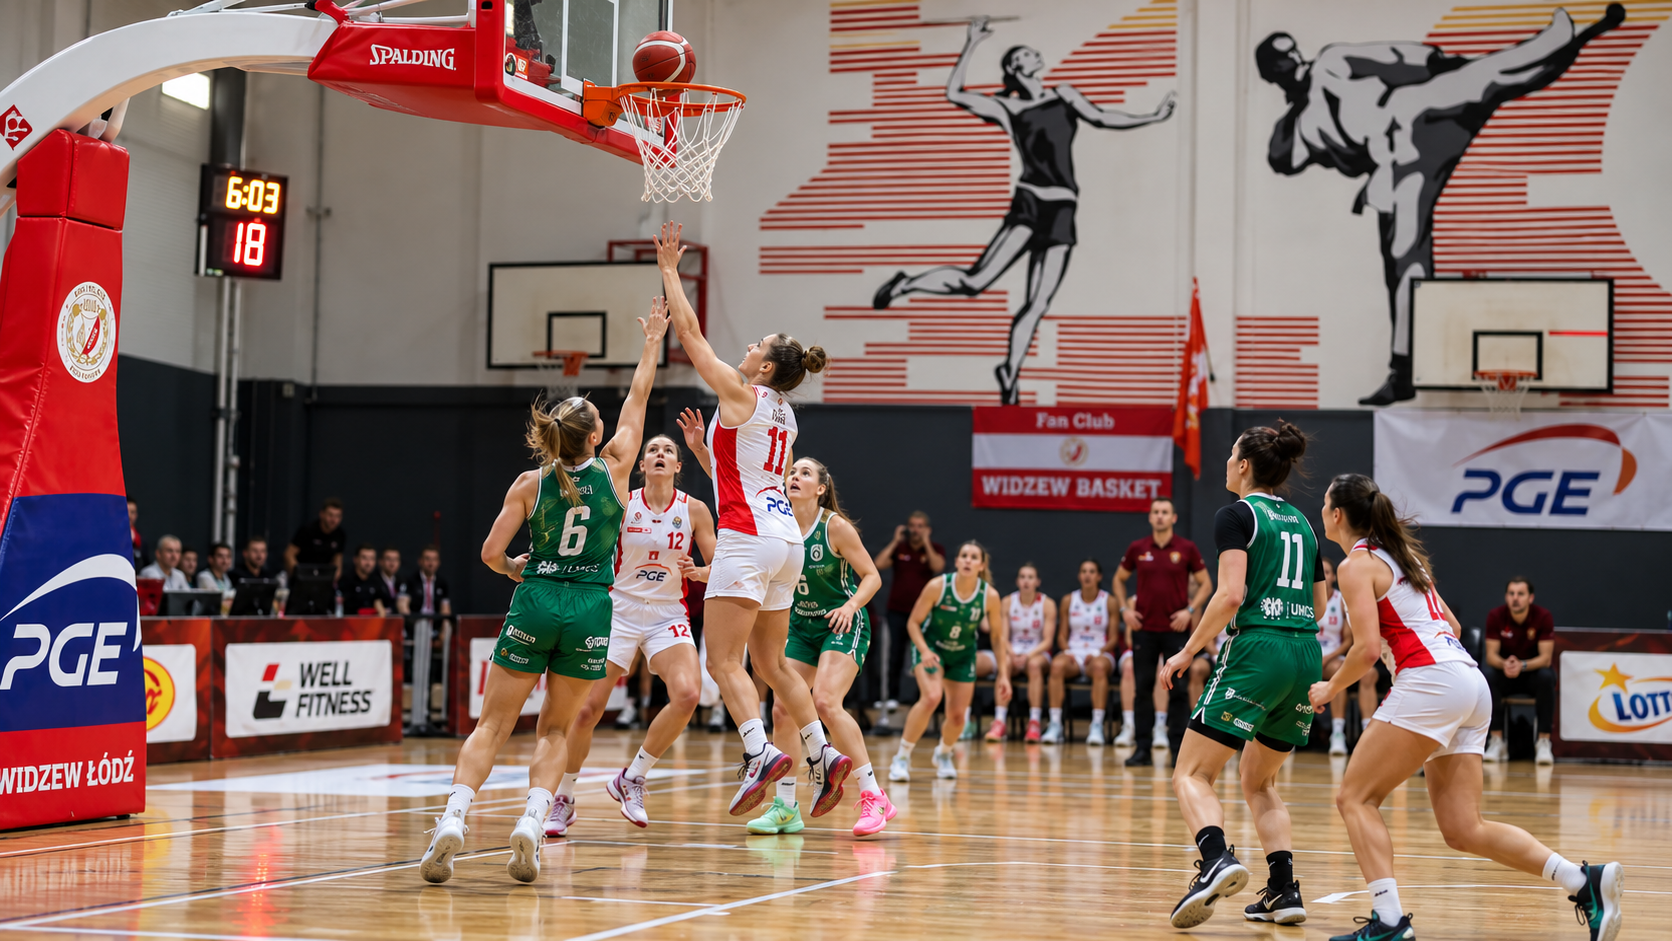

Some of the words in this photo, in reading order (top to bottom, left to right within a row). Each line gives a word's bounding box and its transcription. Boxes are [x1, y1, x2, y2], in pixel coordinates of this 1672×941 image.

[369, 43, 457, 71] SPALDING
[225, 176, 281, 214] 6:03
[233, 222, 267, 267] 18
[1035, 412, 1069, 429] Fan
[1072, 413, 1115, 430] Club
[763, 426, 788, 476] 11
[981, 475, 1070, 496] WIDZEW
[1075, 478, 1162, 499] BASKET
[1450, 468, 1601, 516] PGE
[557, 505, 591, 557] 6
[667, 531, 684, 550] 12
[636, 569, 667, 582] PGE
[1276, 531, 1304, 590] 11
[668, 623, 690, 638] 12
[949, 625, 962, 639] 8
[0, 621, 128, 690] PGE
[300, 660, 352, 688] WELL
[295, 689, 372, 718] FITNESS
[1612, 690, 1672, 721] LOTT
[0, 760, 83, 795] WIDZEW
[86, 749, 135, 787] ŁÓDŹ
